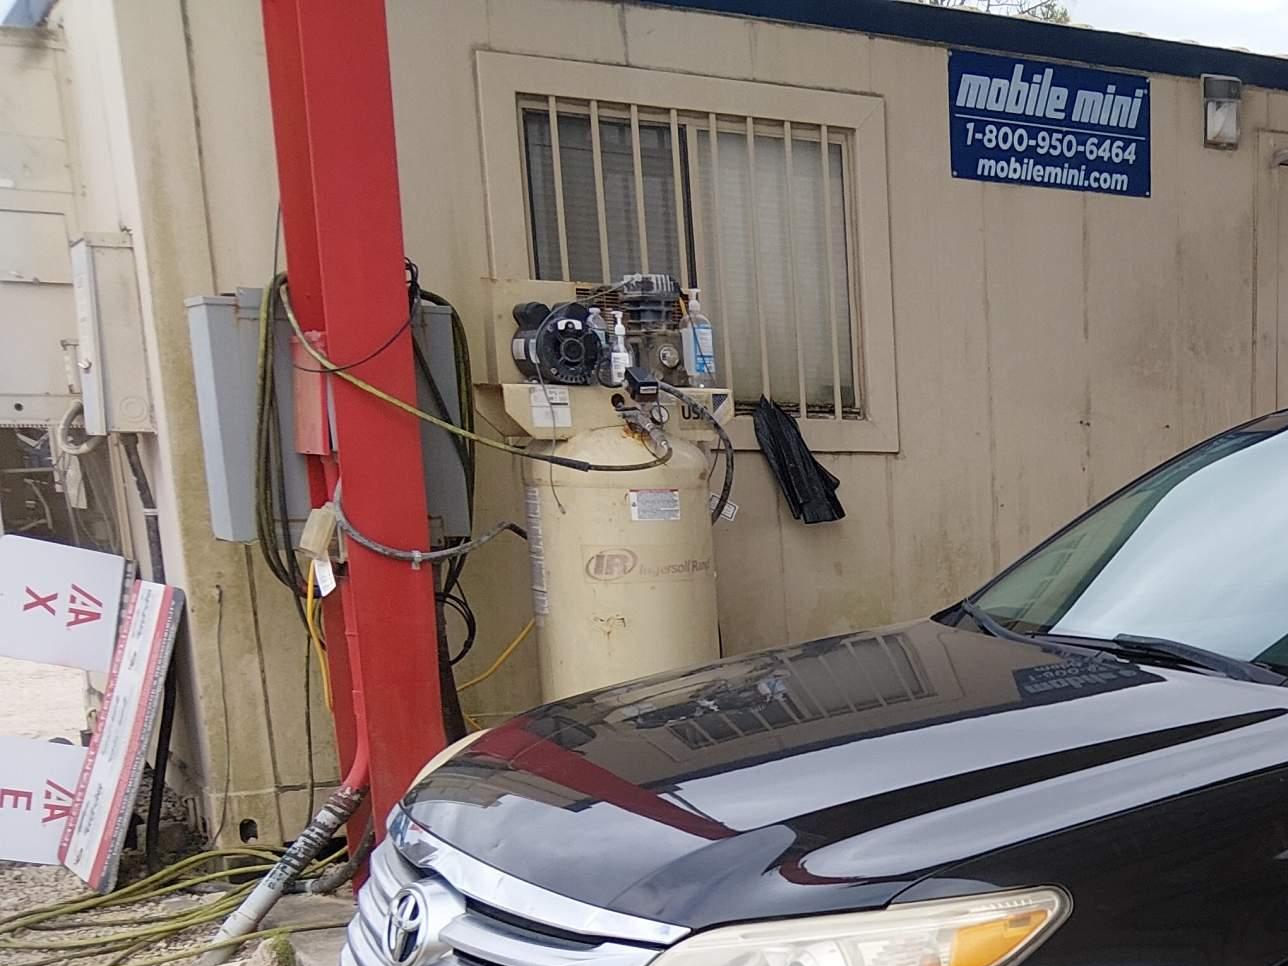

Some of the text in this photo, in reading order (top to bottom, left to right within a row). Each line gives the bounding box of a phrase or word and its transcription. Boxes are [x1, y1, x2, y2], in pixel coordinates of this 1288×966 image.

[955, 63, 1144, 129] mobile mini
[965, 122, 1137, 165] 1-800-950-6464
[976, 156, 1129, 191] mobilemini.com
[23, 585, 58, 616] X
